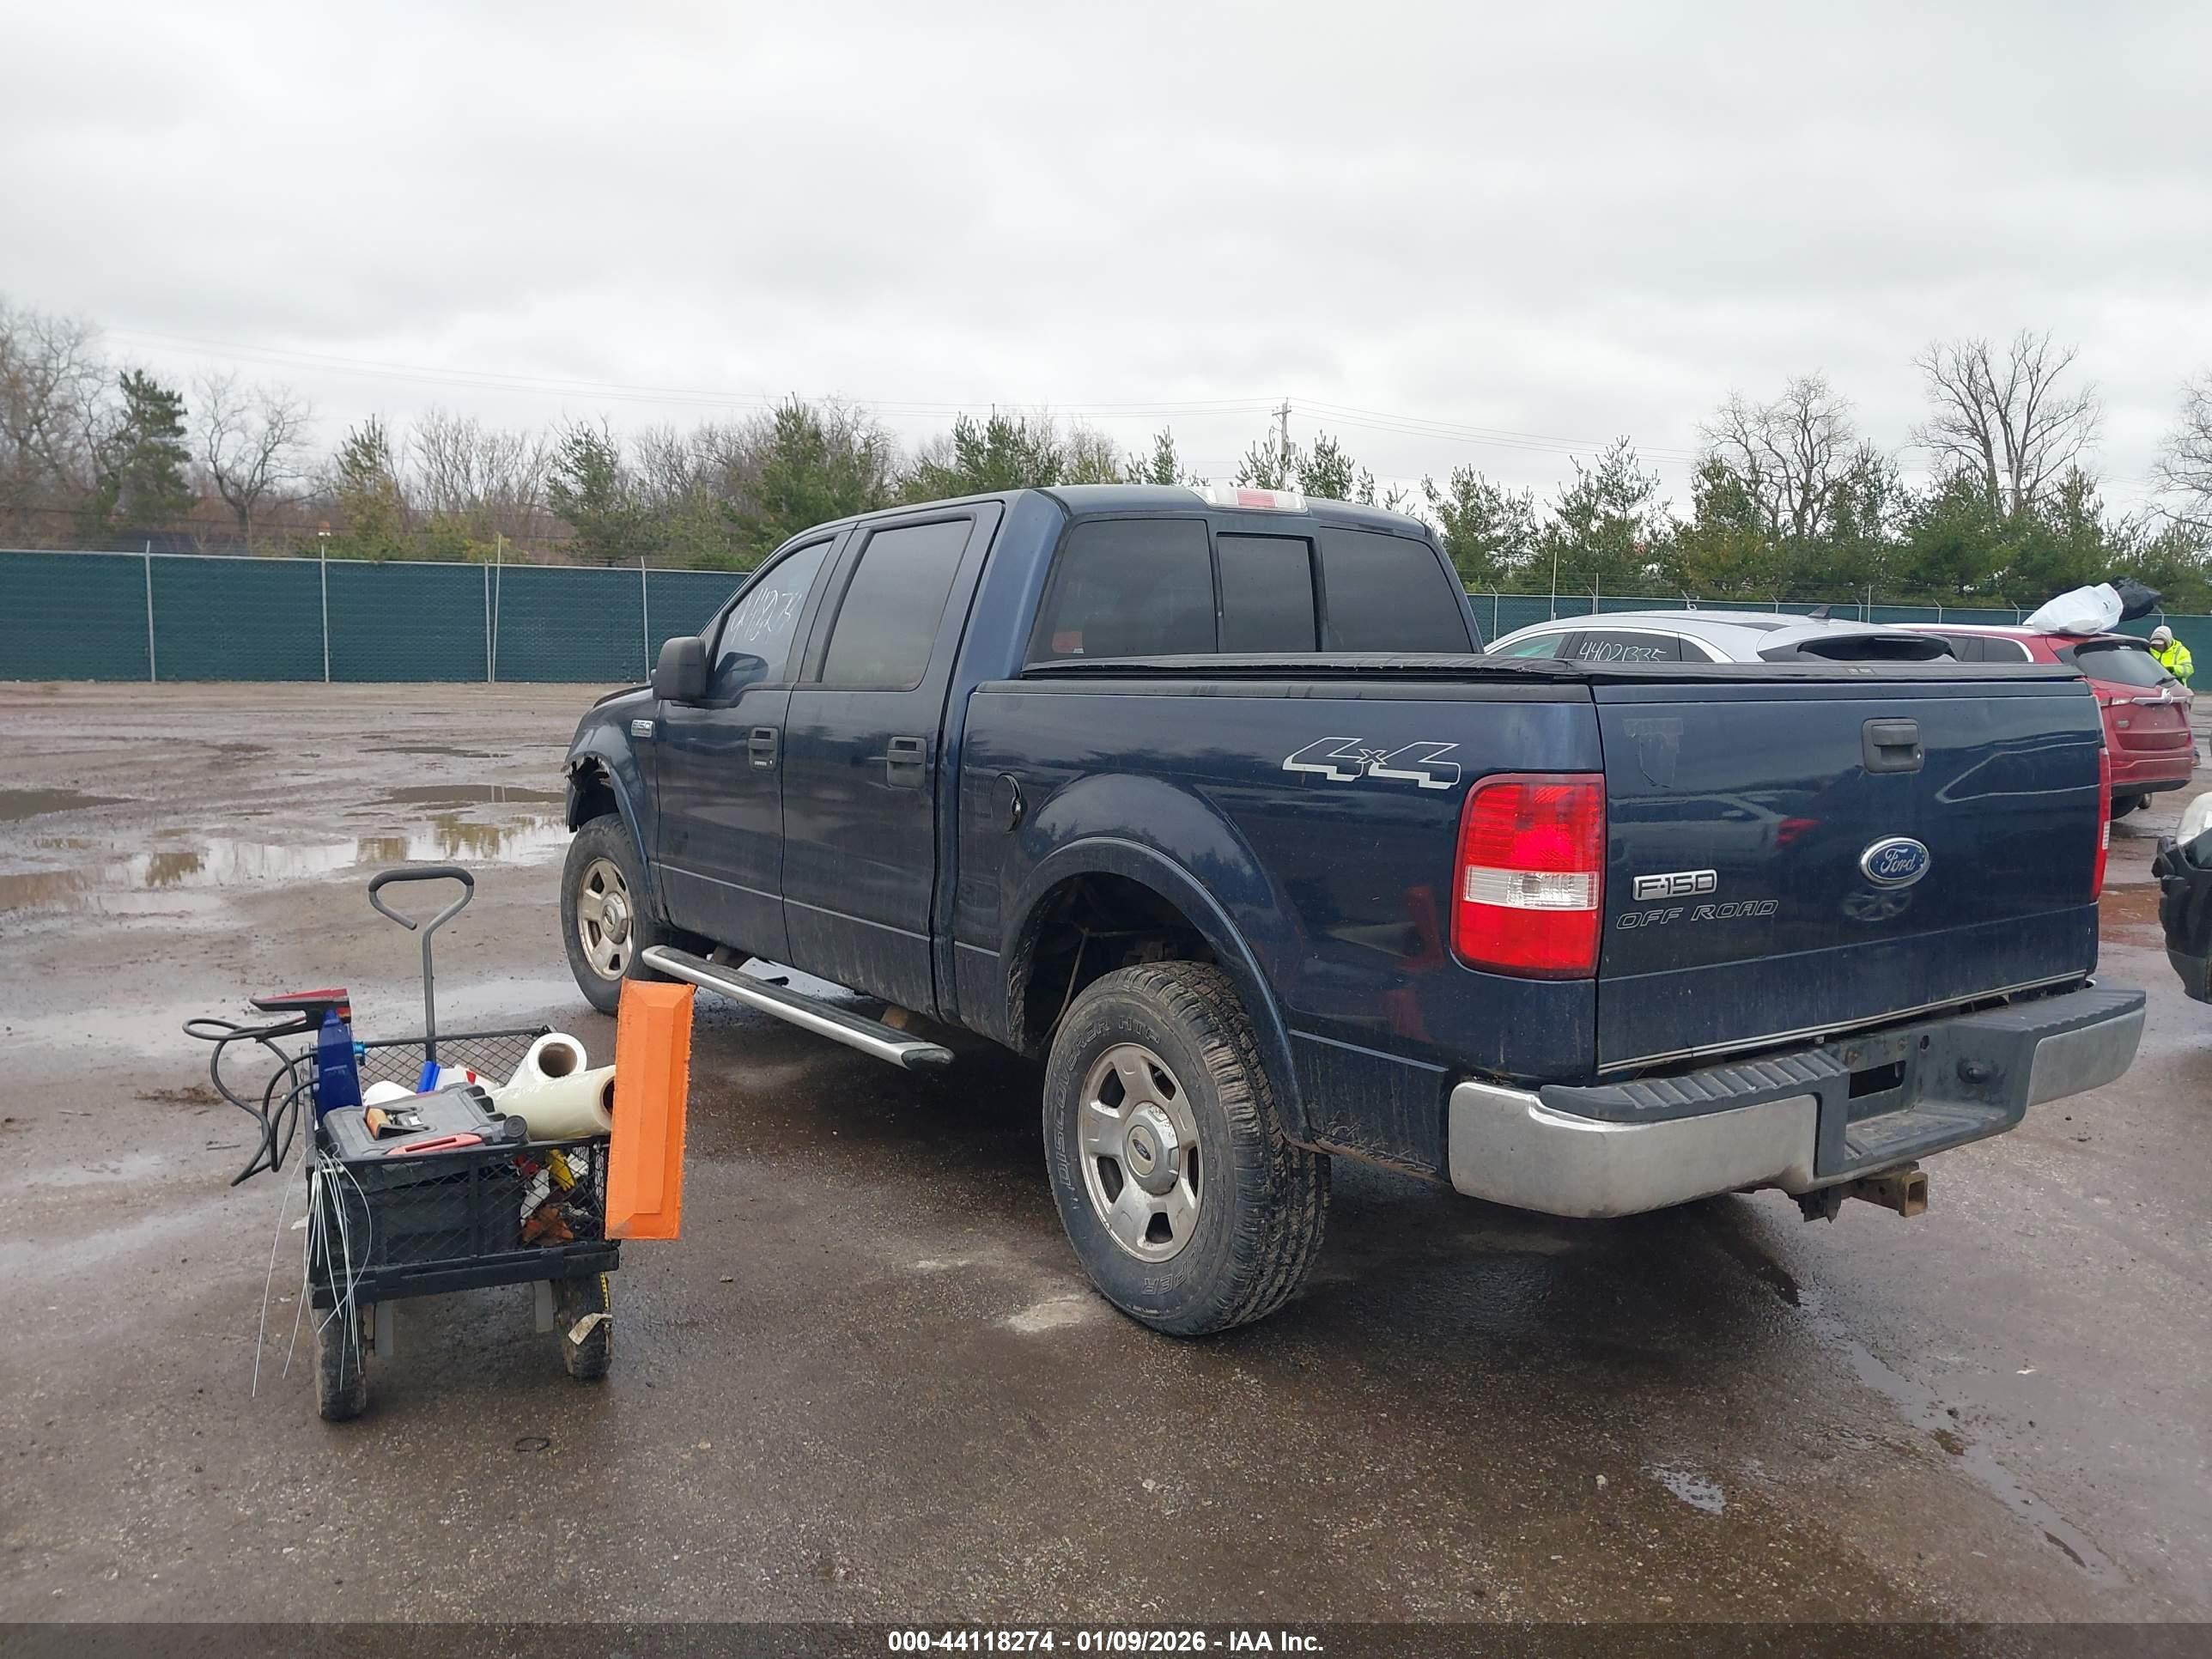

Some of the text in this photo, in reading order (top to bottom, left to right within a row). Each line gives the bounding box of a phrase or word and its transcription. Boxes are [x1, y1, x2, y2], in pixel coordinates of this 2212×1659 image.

[1580, 641, 1668, 662] 44021335
[1617, 900, 1779, 929] OFF ROAD
